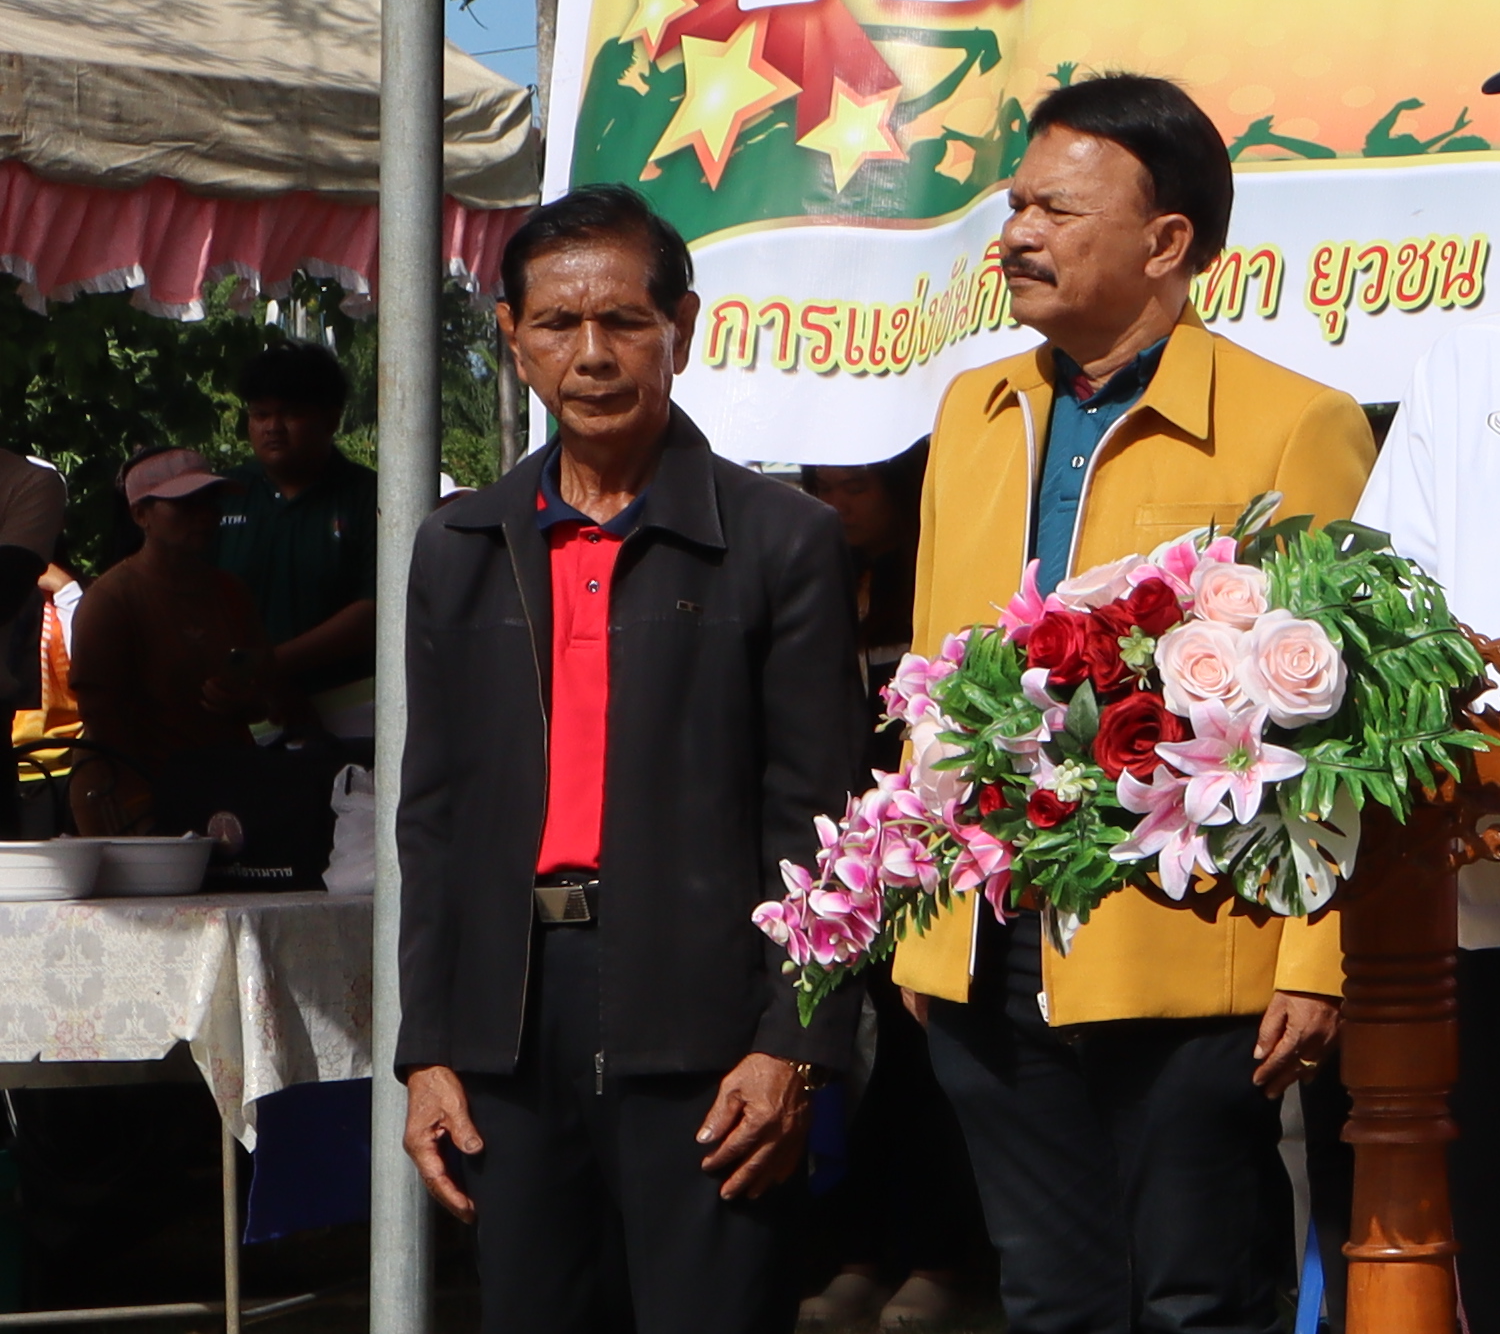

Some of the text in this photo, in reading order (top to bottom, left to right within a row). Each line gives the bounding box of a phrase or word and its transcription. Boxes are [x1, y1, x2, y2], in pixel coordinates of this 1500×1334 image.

[705, 237, 1012, 368] การแข่งขันกี
[1307, 236, 1484, 334] ยุวชน
